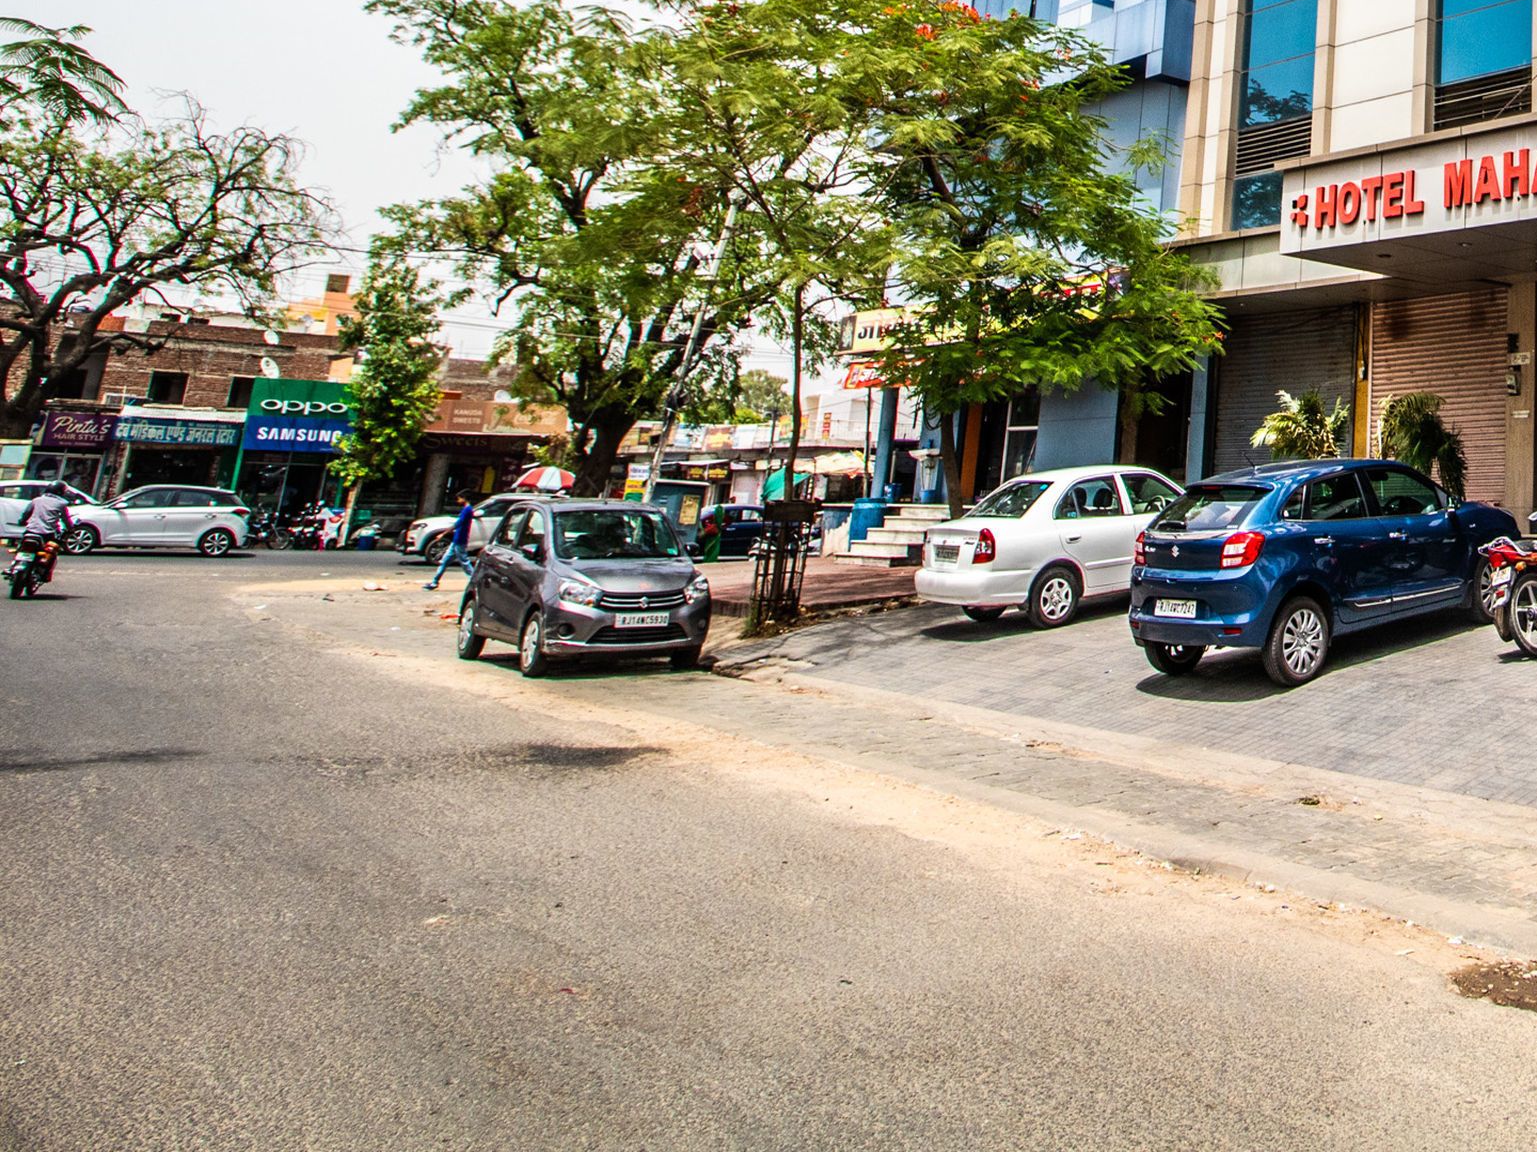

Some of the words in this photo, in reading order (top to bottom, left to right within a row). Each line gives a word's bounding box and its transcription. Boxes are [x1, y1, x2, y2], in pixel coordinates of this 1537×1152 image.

[1314, 169, 1425, 230] HOTEL
[52, 415, 112, 435] Pintu's
[53, 433, 77, 441] HAIR
[78, 434, 105, 442] STYLE
